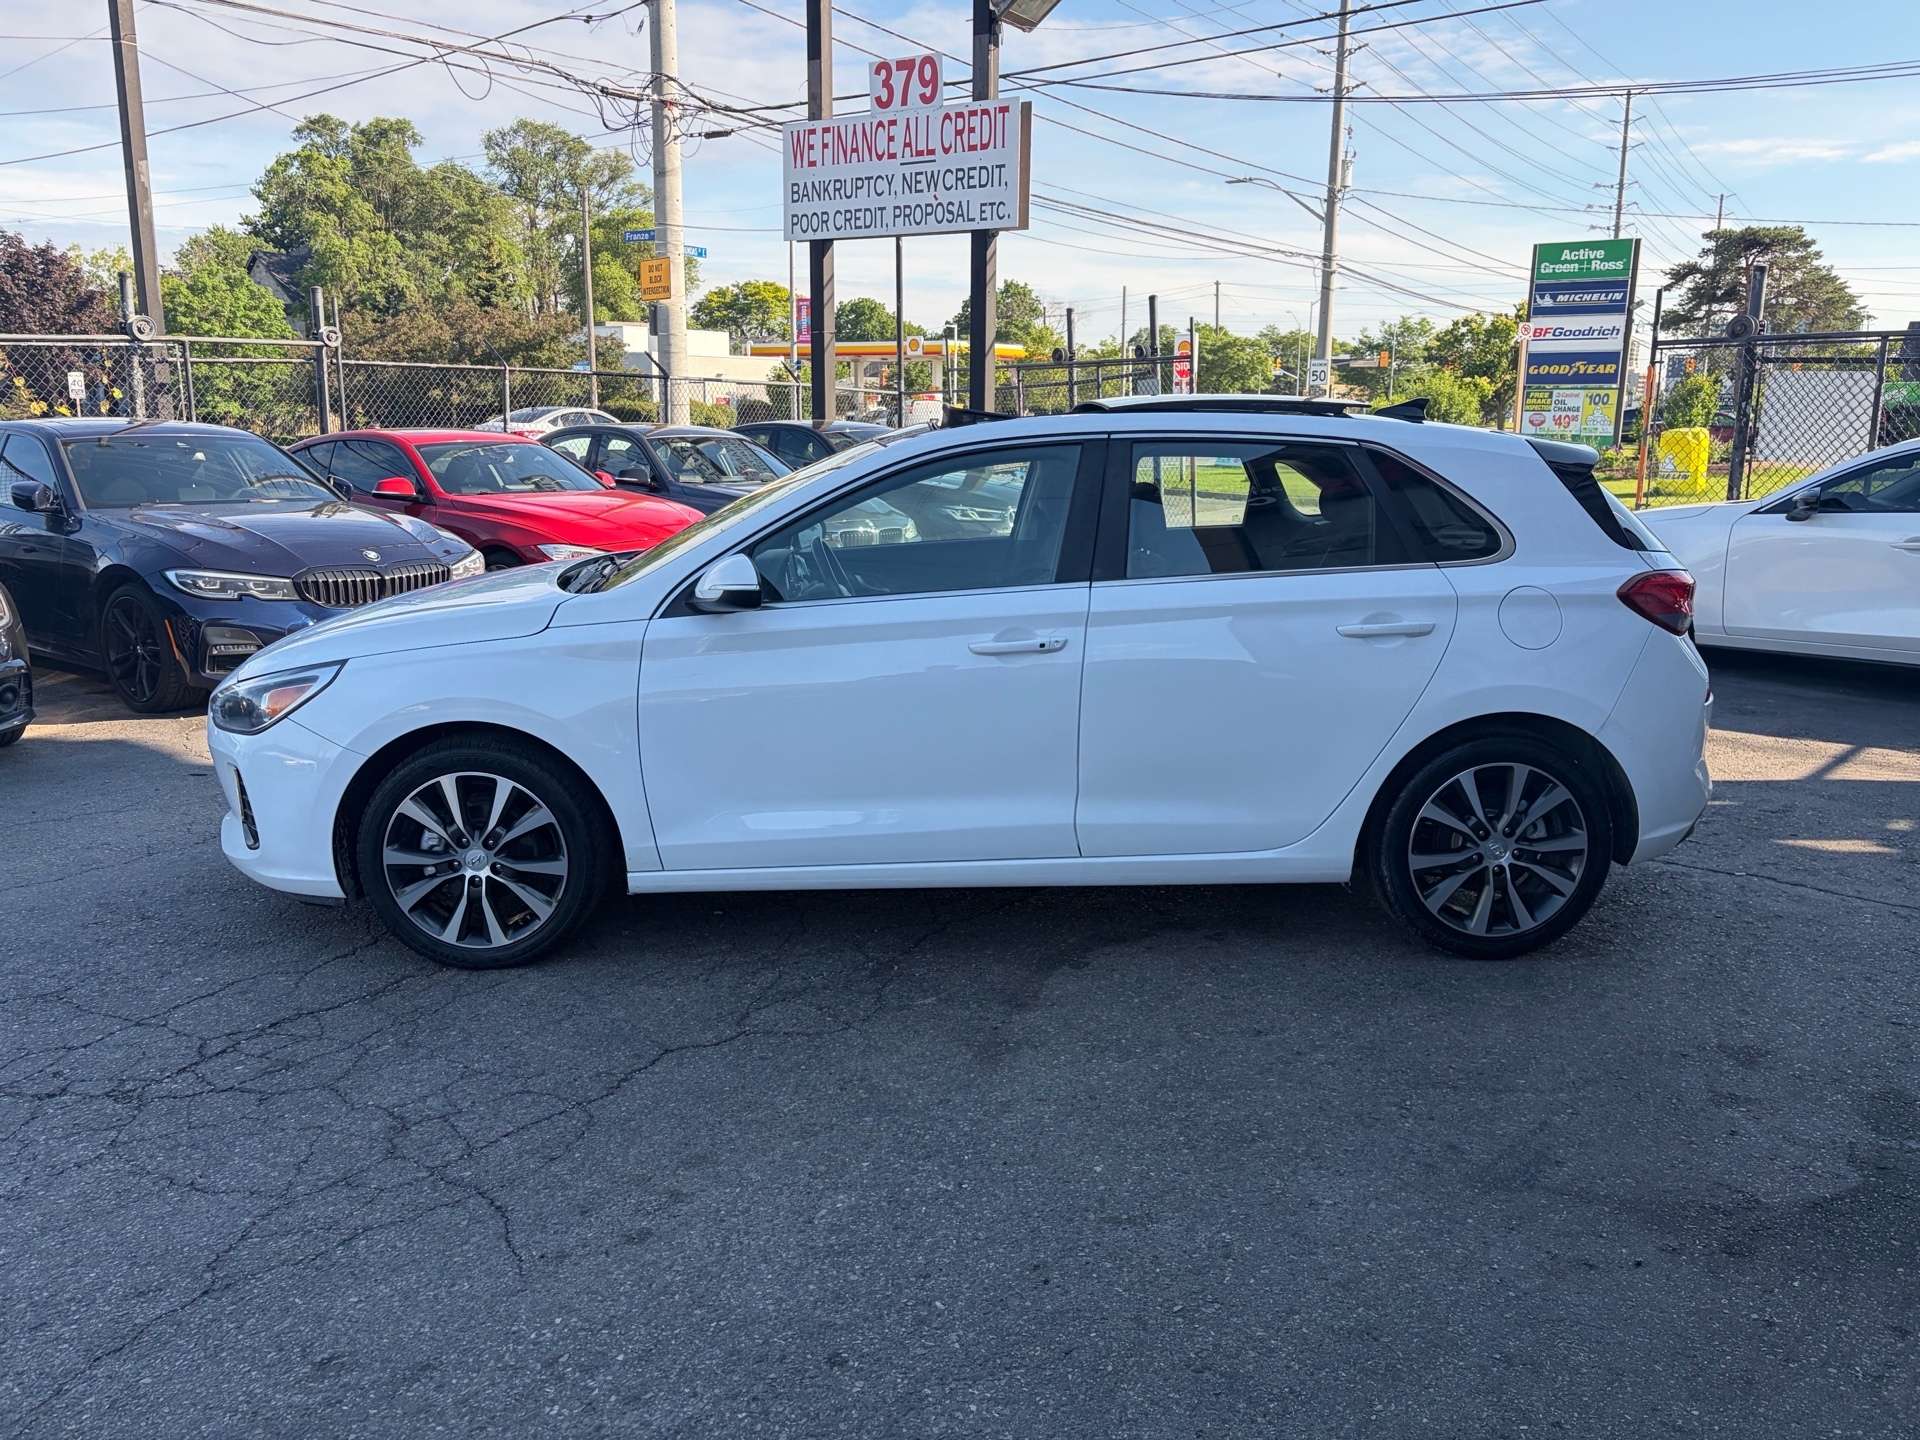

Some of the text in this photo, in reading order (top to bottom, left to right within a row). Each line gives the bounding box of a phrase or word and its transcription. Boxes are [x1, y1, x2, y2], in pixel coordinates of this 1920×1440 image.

[874, 55, 939, 109] 379
[791, 105, 1009, 168] WE FINANCE ALL CREDIT
[791, 164, 1008, 204] BANKRUPTCY, NEW CREDIT,
[791, 211, 829, 234] POOR
[833, 206, 889, 232] CREDIT,
[980, 201, 1011, 220] ETC.
[1561, 249, 1605, 260] Active
[1556, 293, 1624, 302] MICHELIN
[1532, 326, 1620, 337] BFGoodrich
[1312, 370, 1326, 381] 50
